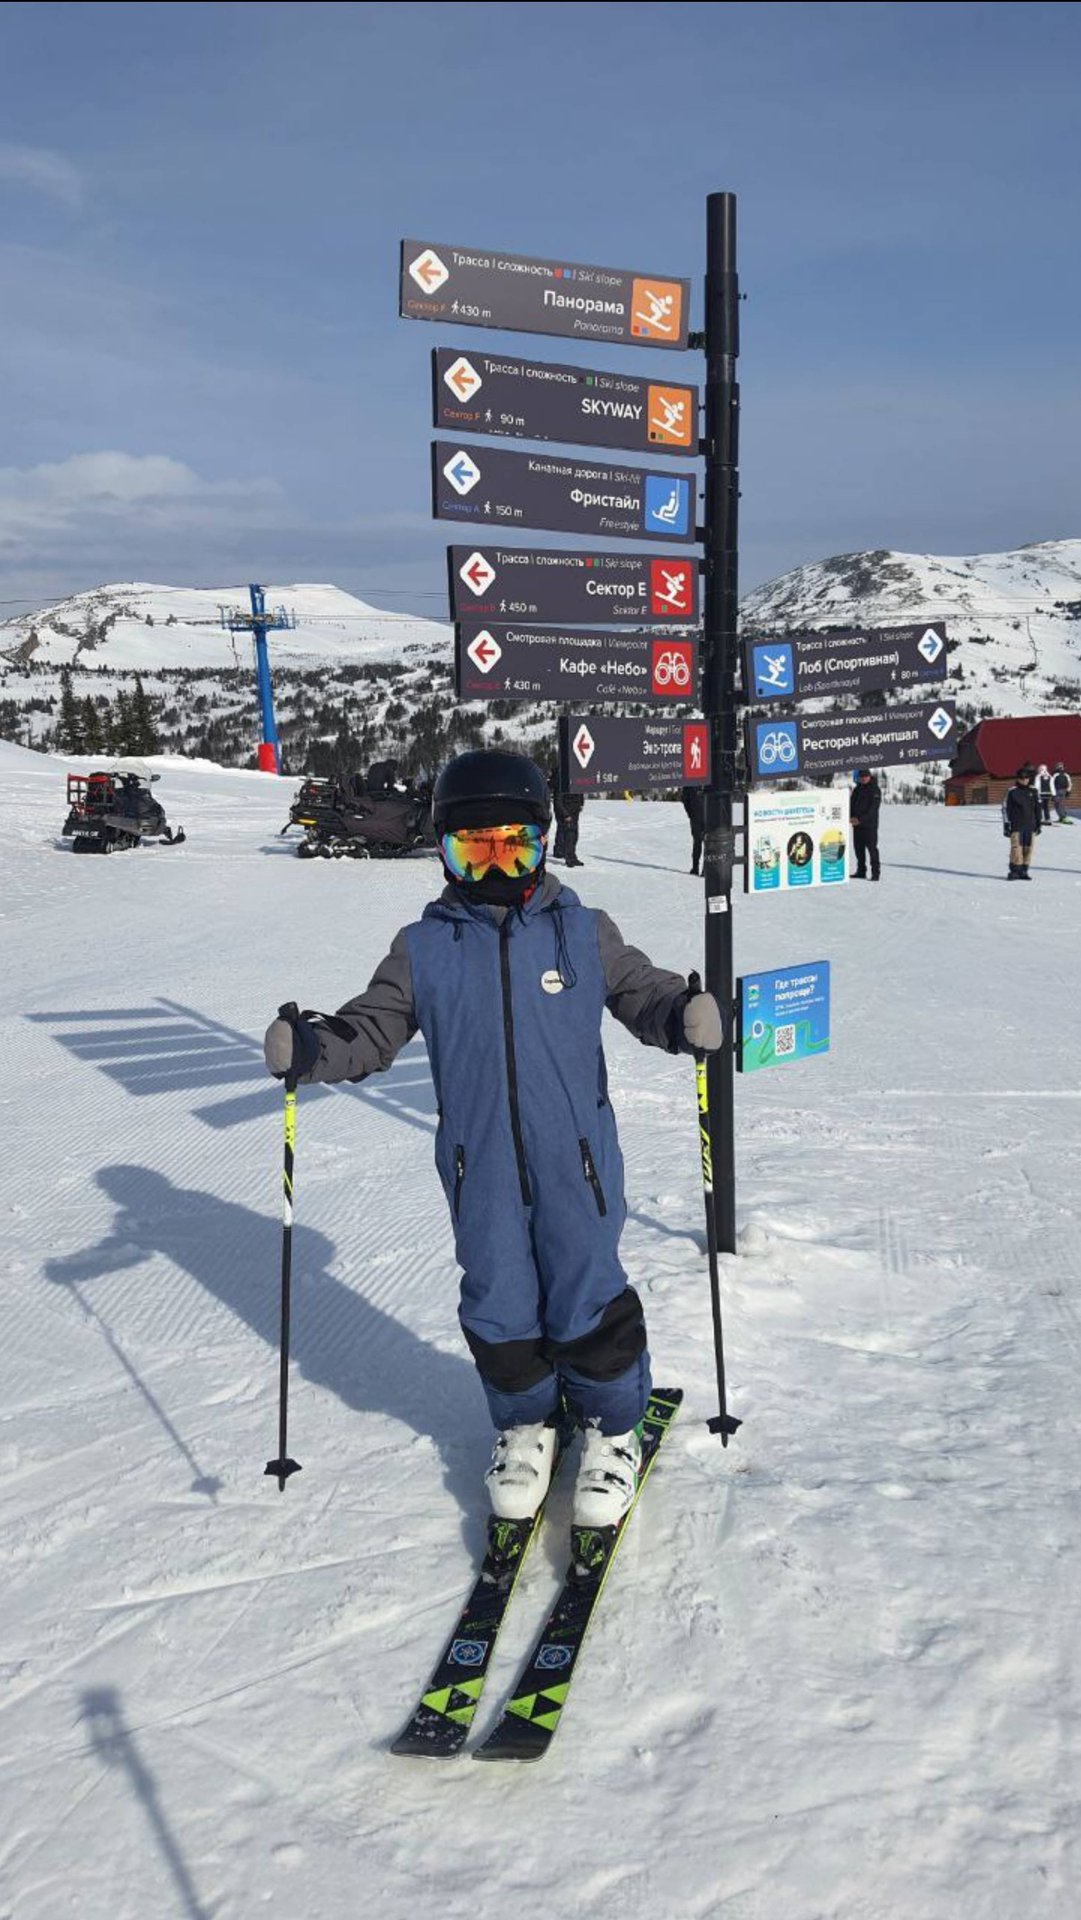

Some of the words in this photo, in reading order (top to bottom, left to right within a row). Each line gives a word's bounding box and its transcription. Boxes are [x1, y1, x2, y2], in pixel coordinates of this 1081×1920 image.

[452, 252, 490, 267] Трасса
[497, 262, 554, 277] сложность
[578, 271, 594, 281] Ski
[595, 273, 622, 286] slope
[460, 304, 480, 317] 430
[543, 290, 625, 315] Панорама
[573, 319, 625, 335] Panorama
[484, 360, 519, 374] Трасса
[526, 368, 578, 384] сложность
[599, 378, 613, 389] Ski
[614, 380, 640, 393] slope
[581, 398, 643, 420] SKYWAY
[500, 413, 514, 425] 90
[528, 460, 572, 476] Канатная
[574, 469, 608, 481] дорога
[570, 488, 640, 511] Фристайл
[495, 505, 512, 517] 150
[599, 517, 640, 532] Freestyle
[495, 551, 529, 565] Трасса
[536, 556, 585, 568] сложность
[586, 580, 635, 599] Сектор
[508, 602, 528, 613] 450
[506, 631, 556, 646] Смотровая
[558, 636, 602, 649] площадка
[796, 642, 823, 653] Трасса
[560, 658, 598, 678] Кафе
[600, 660, 648, 677] «Небо»
[798, 660, 822, 675] Лоб
[824, 650, 900, 675] (Спортивная)
[901, 671, 911, 680] 80
[513, 680, 531, 692] 430
[801, 718, 844, 729] Смотровая
[845, 714, 883, 725] площадка
[803, 737, 859, 752] Ресторан
[861, 731, 919, 747] Каритшал
[775, 979, 789, 991] Где
[790, 974, 818, 989] трассы
